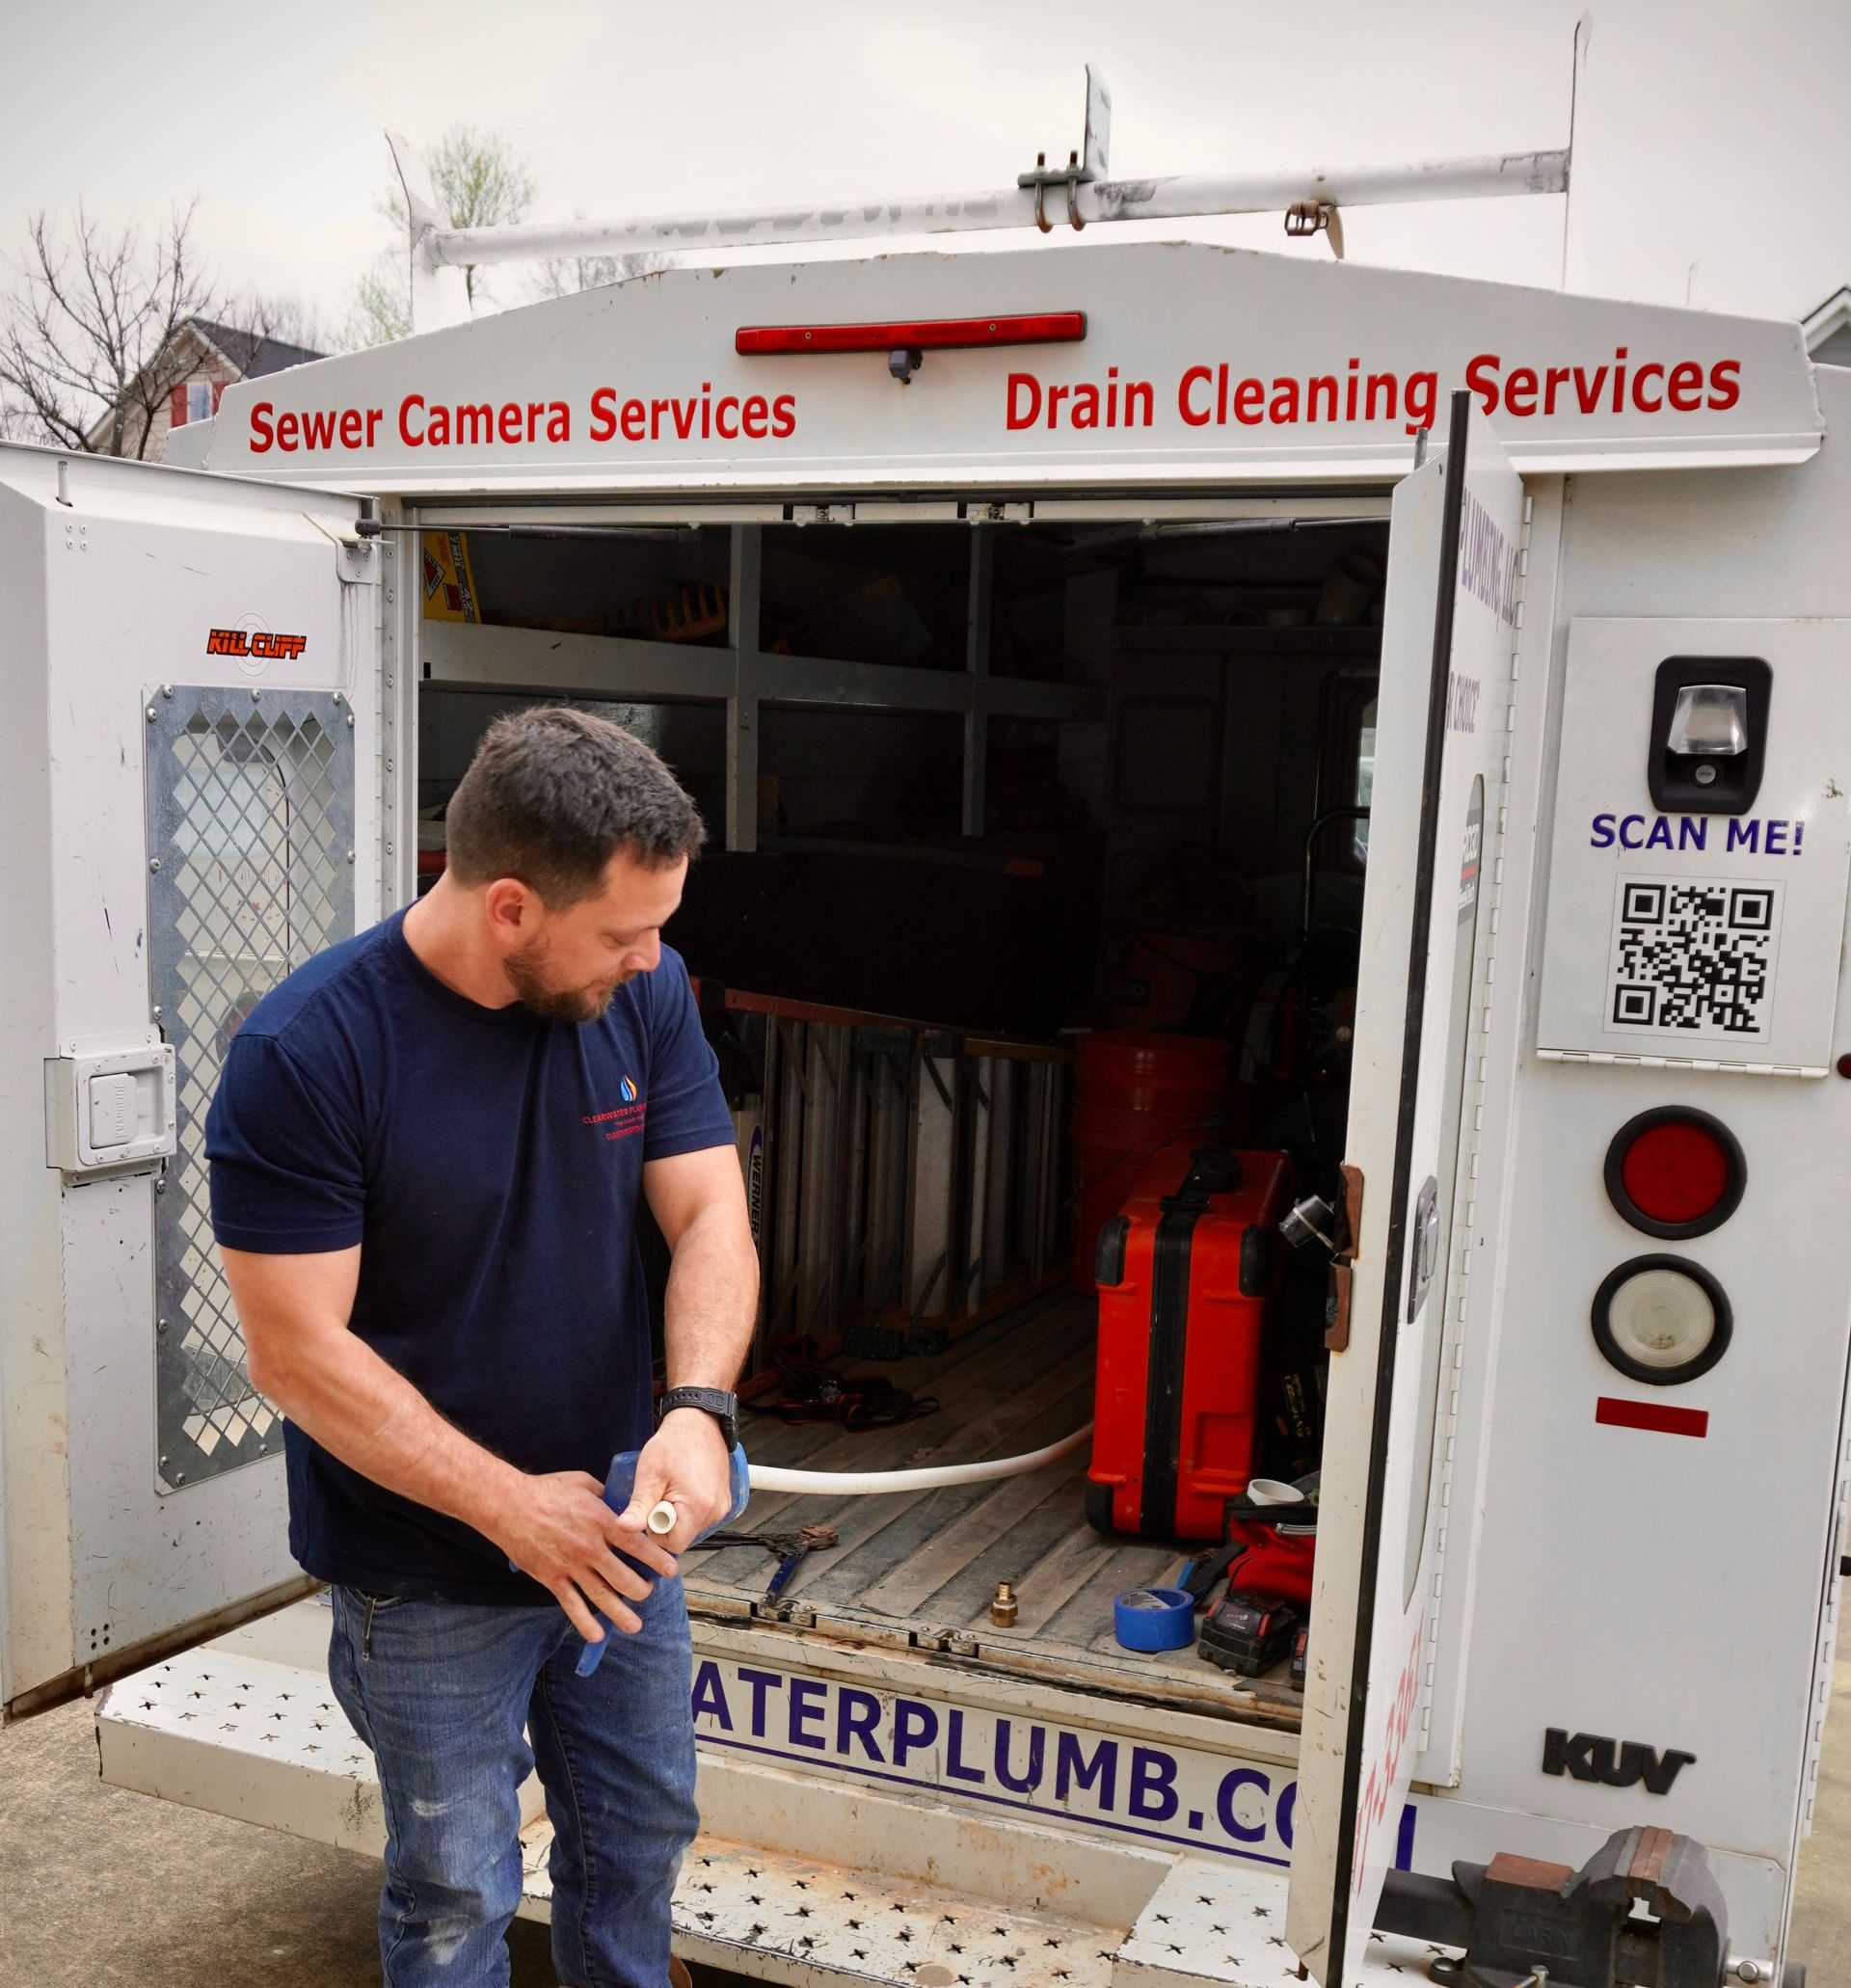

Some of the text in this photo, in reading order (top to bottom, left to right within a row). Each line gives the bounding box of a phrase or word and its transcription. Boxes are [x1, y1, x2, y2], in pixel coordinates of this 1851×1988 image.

[249, 382, 796, 454] Sewer Camera Services
[1006, 347, 1742, 436] Drain Cleaning Services
[206, 628, 307, 659] KILL CLIFF
[1591, 813, 1806, 856] SCAN ME!
[752, 1155, 763, 1234] WERNER
[1542, 1727, 1698, 1795] KUV
